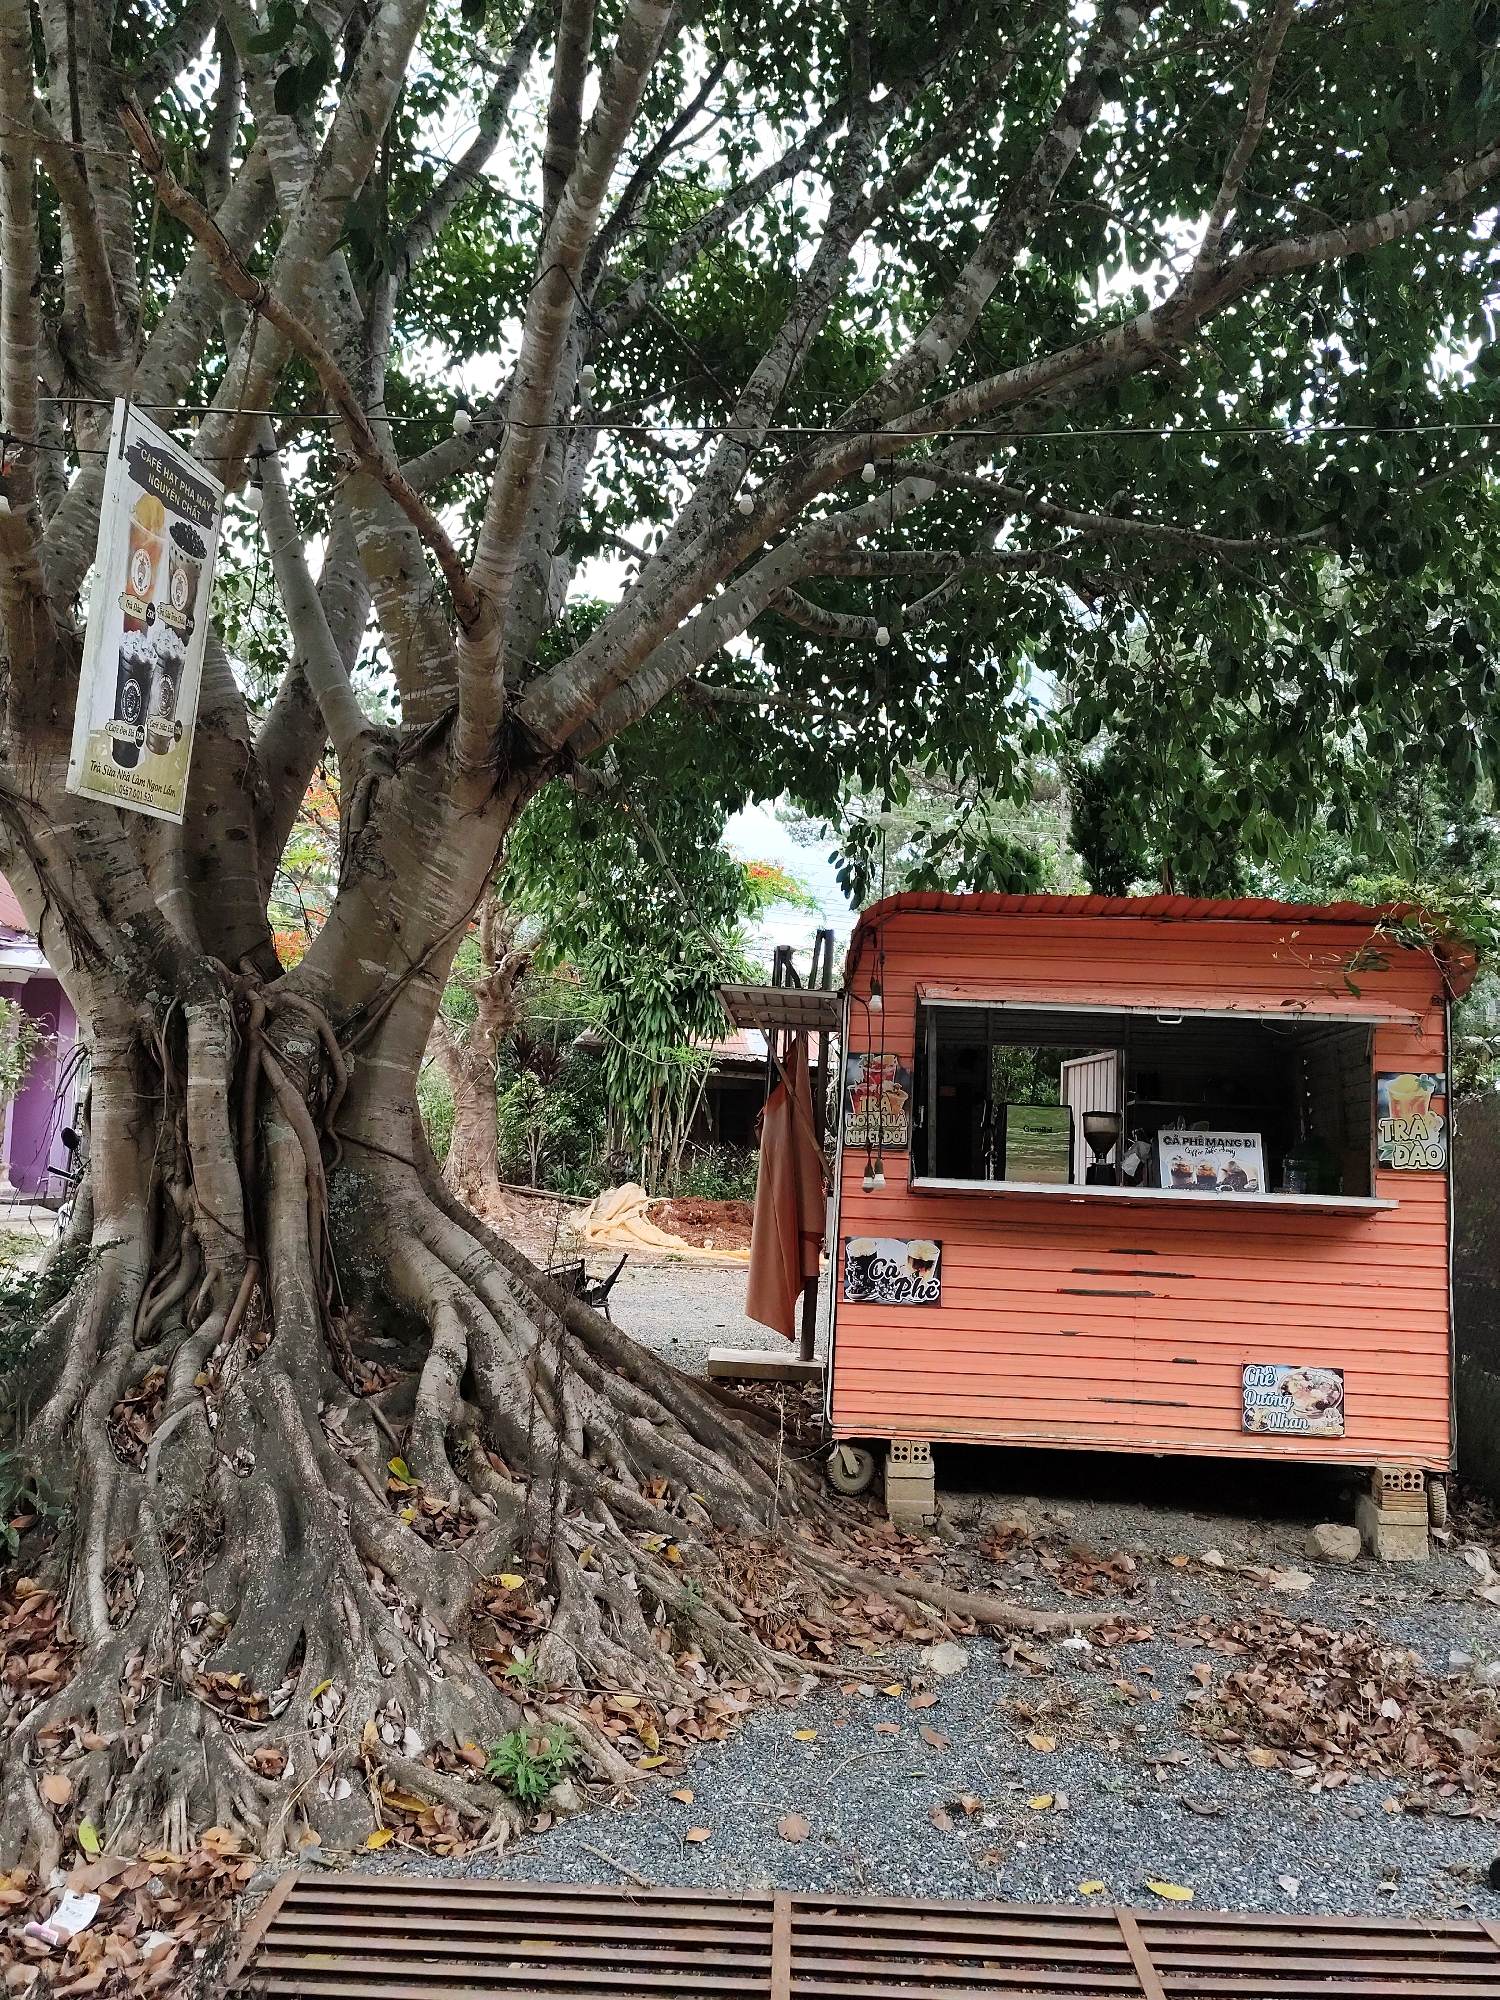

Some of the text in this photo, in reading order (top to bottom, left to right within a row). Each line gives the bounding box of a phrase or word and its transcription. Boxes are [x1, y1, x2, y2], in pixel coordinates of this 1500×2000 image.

[140, 449, 212, 512] CAFÉ HẠT PHA MÁY
[90, 760, 101, 773] Trà
[1381, 1114, 1428, 1142] TRÀ
[1181, 1135, 1204, 1146] PHÊ
[1205, 1137, 1242, 1148] MANG
[1393, 1140, 1443, 1167] ĐÀO
[868, 1258, 900, 1280] Cà
[895, 1276, 939, 1300] Phê
[1244, 1366, 1276, 1387] Chè
[1268, 1411, 1309, 1430] Nhan
